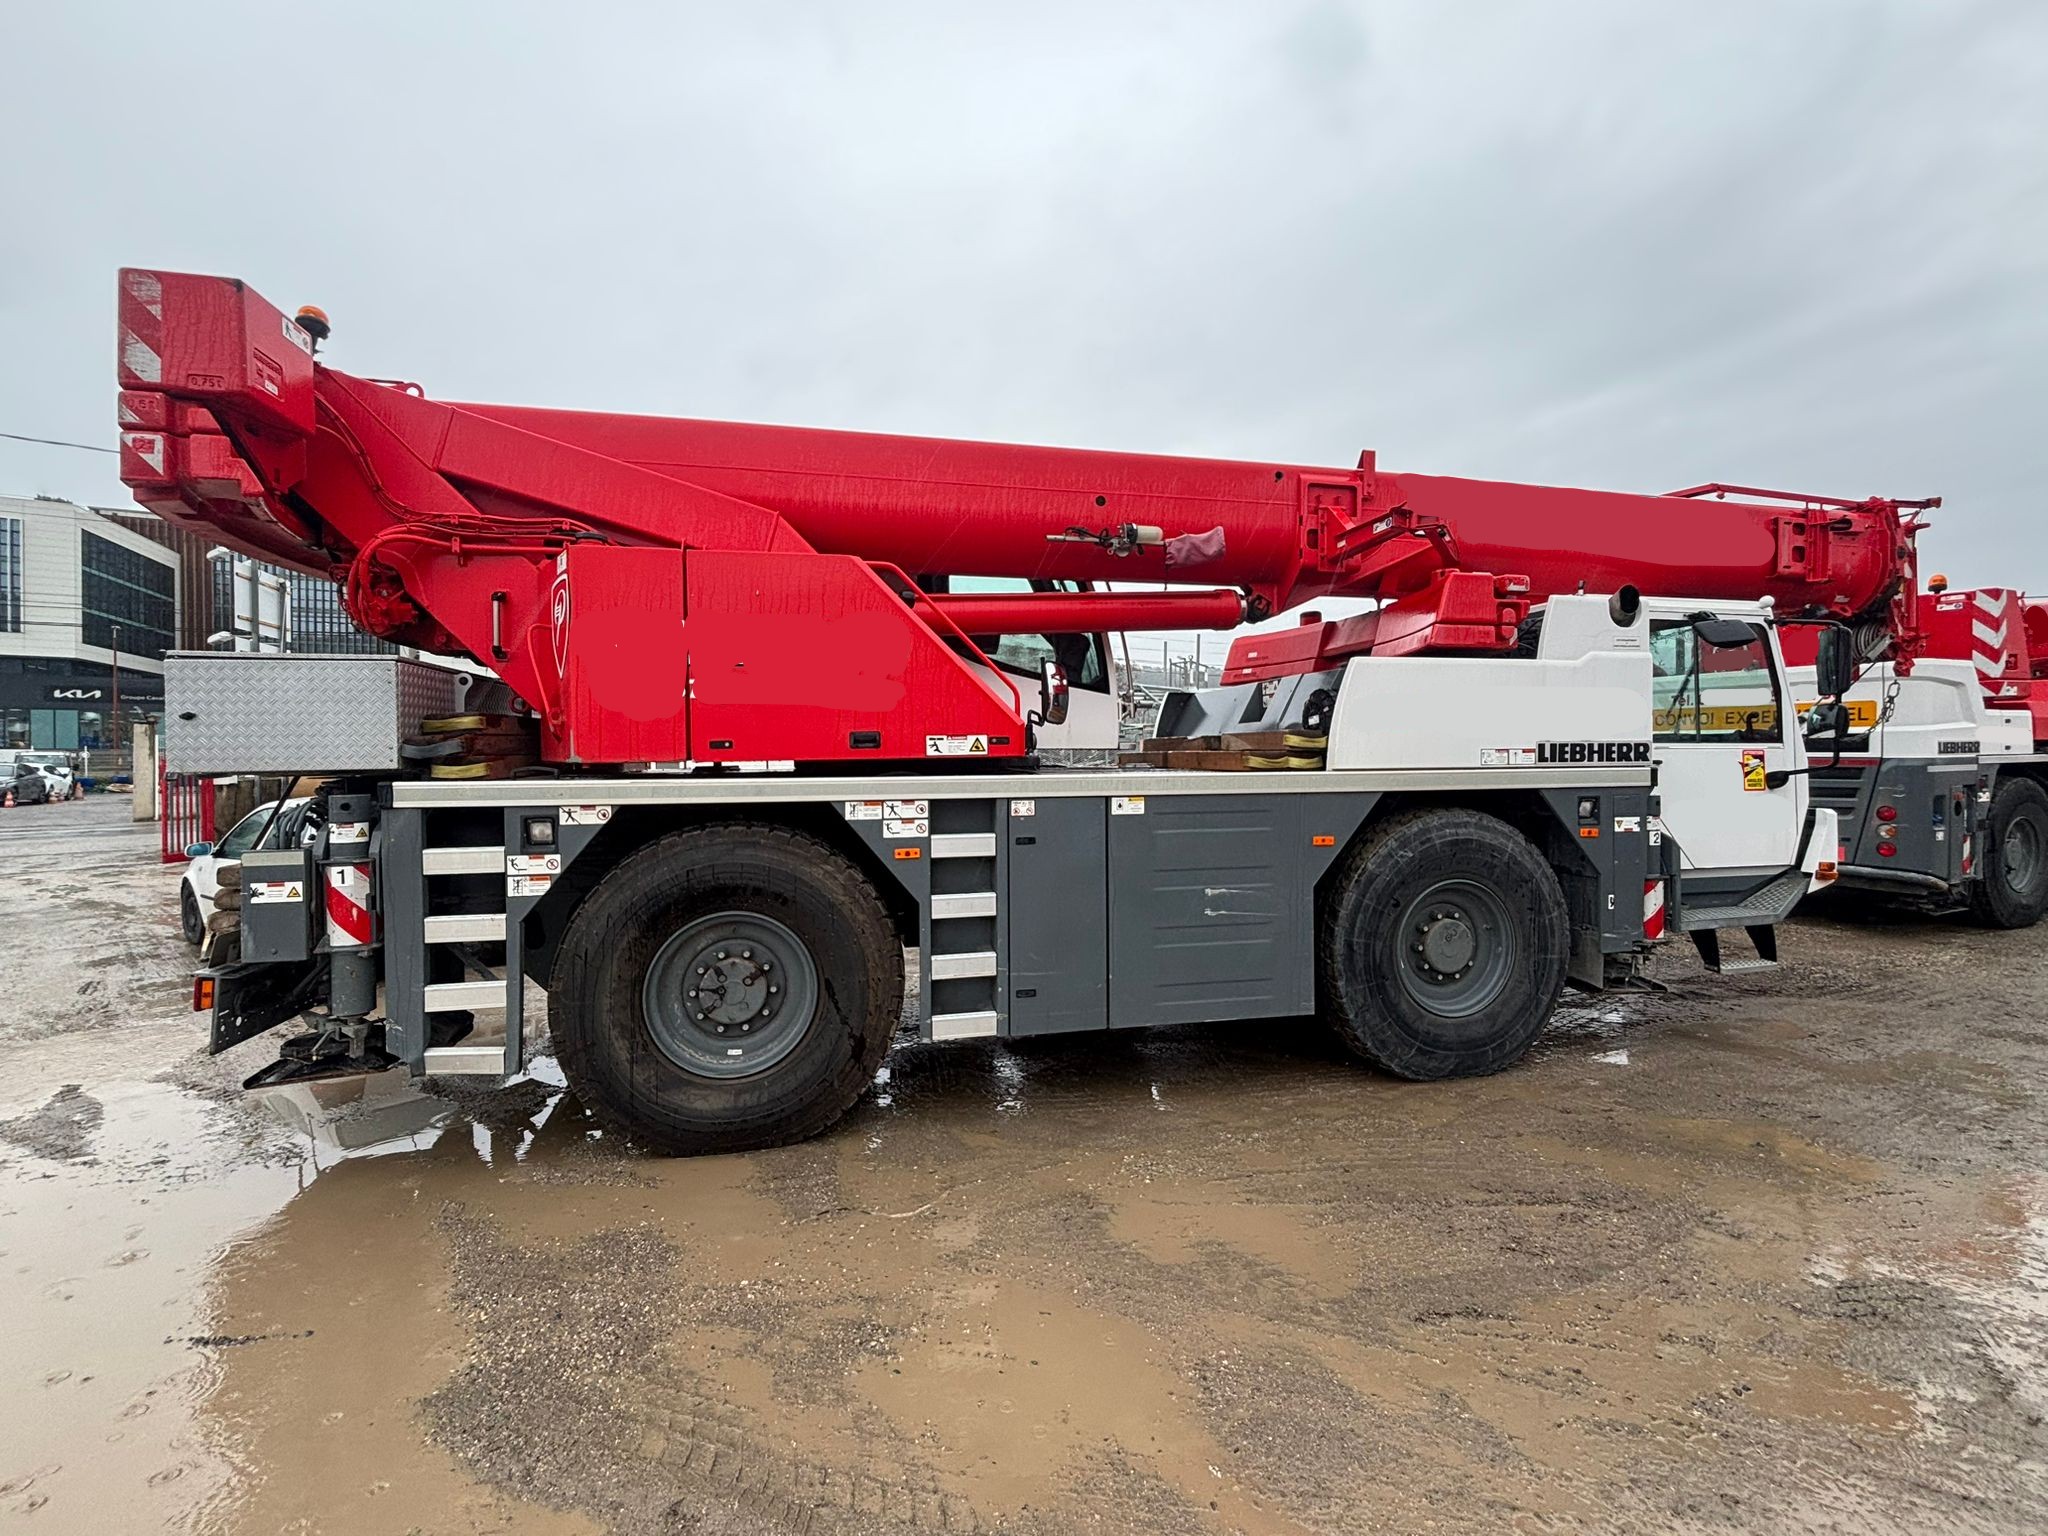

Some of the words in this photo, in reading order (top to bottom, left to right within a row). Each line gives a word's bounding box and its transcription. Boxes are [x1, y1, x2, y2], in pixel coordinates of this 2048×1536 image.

[54, 689, 101, 699] KIA
[1538, 743, 1650, 763] LIEBHERR
[1938, 741, 1980, 754] LIEBHERR
[1653, 832, 1660, 844] 2
[336, 869, 345, 885] 1
